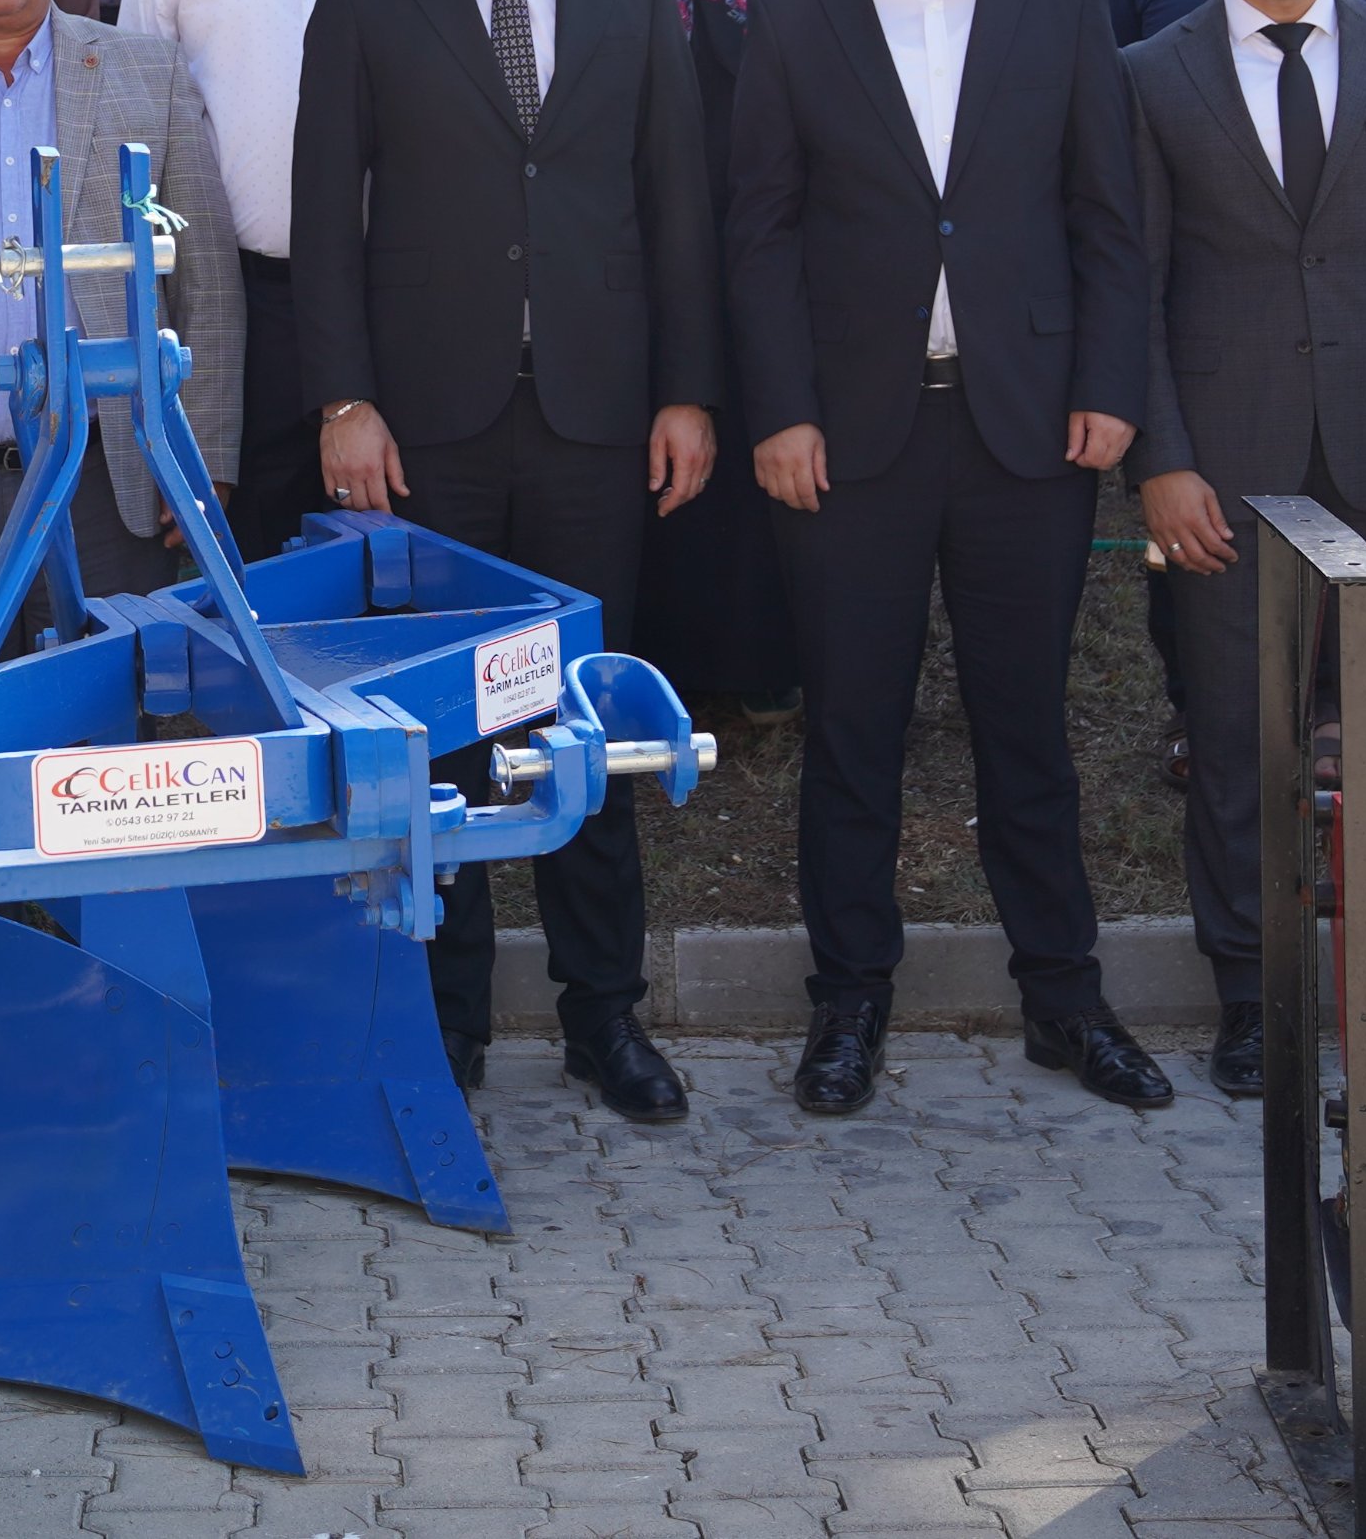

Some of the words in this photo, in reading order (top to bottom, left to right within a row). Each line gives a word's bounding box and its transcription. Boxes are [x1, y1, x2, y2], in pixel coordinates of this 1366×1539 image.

[485, 679, 512, 697] TARIM
[514, 660, 555, 687] ALETLERİ
[57, 797, 128, 815] TARIM
[135, 785, 247, 810] ALETLERİ
[115, 815, 142, 827] 0543
[144, 814, 164, 824] 612
[166, 812, 180, 822] 97
[182, 811, 195, 821] 21
[83, 837, 100, 846] Yeni
[100, 835, 126, 846] Sanayi
[127, 833, 149, 842] Sitesi
